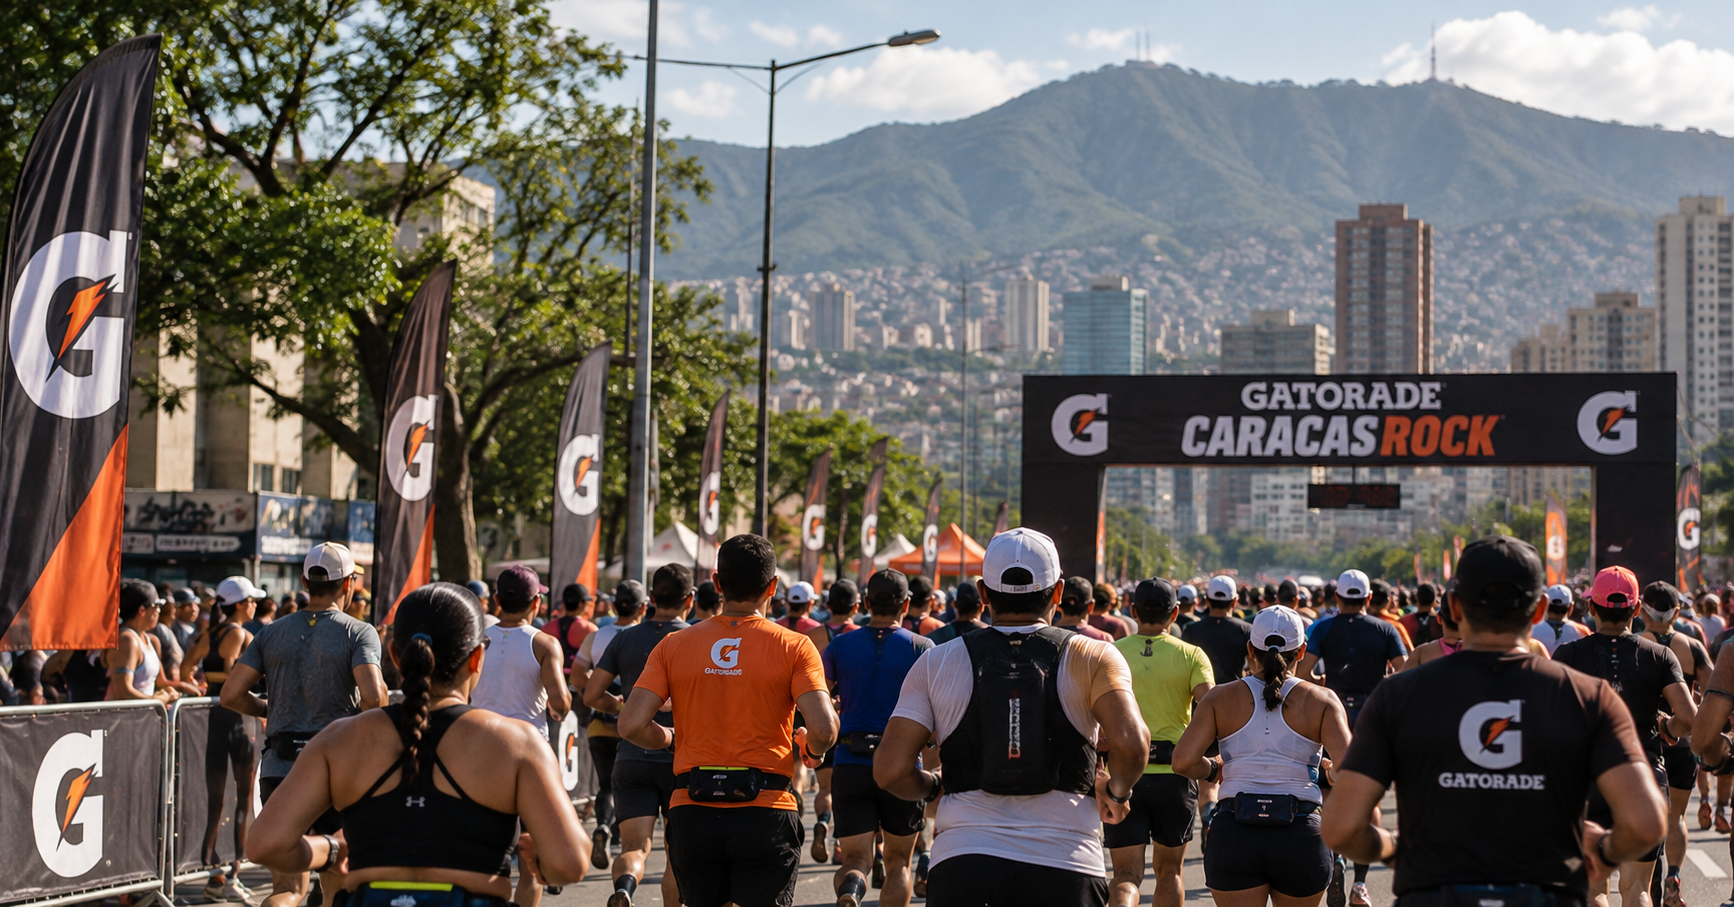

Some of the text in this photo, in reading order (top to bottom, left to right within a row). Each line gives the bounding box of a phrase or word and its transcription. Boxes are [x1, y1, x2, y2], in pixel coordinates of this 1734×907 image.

[8, 229, 127, 419] G
[1051, 394, 1109, 456] G
[1241, 382, 1441, 410] GATORADE
[1577, 391, 1637, 455] G
[386, 394, 438, 501] G
[1181, 415, 1499, 457] CARACAS ROCK
[556, 433, 601, 515] G
[710, 637, 743, 668] G
[1459, 699, 1522, 769] G
[32, 729, 105, 879] G
[1438, 773, 1546, 790] GATORADE
